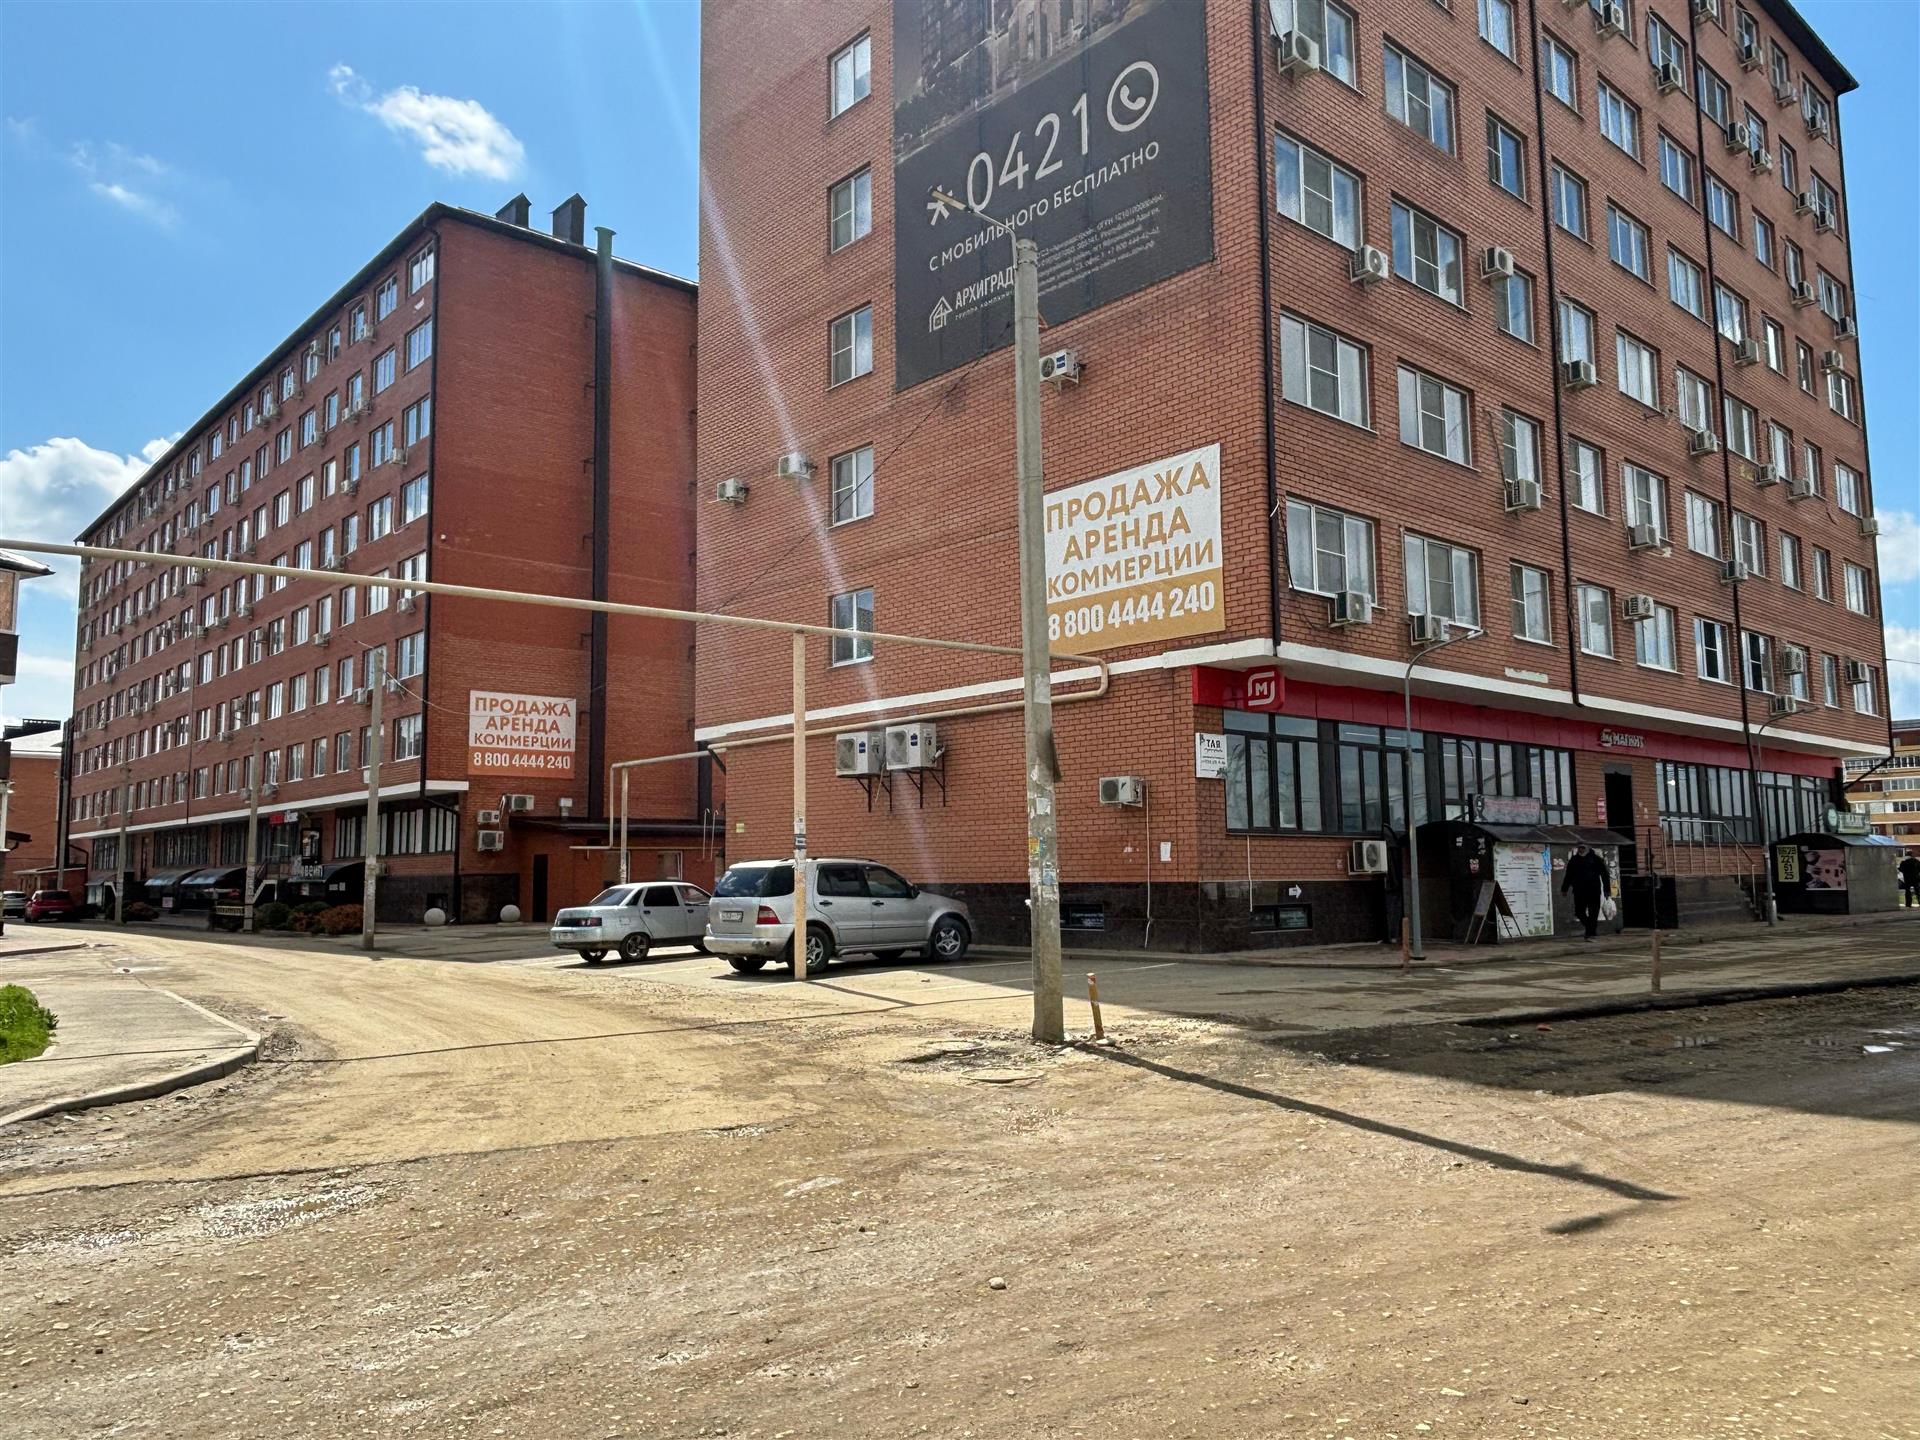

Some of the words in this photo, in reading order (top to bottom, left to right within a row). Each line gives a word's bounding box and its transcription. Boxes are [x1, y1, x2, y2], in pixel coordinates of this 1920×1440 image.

[929, 257, 939, 272] С
[942, 198, 1049, 267] МОБИЛЬНОГО
[1053, 141, 1159, 209] БЕСПЛАТНО
[955, 266, 1014, 310] АРХИГРАД
[1047, 461, 1211, 533] ПРОДАЖА
[1063, 506, 1191, 565] АРЕНДА
[1048, 538, 1213, 599] КОММЕРЦИИ
[1048, 613, 1060, 641] 8
[1065, 604, 1104, 638] 800
[1108, 591, 1165, 629] 4444
[1169, 581, 1215, 617] 240
[475, 697, 571, 717] ПРОДАЖА
[485, 716, 560, 735] АРЕНДА
[474, 733, 571, 749] КОММЕРЦИИ
[474, 752, 482, 766] 8
[485, 752, 510, 767] 800
[512, 754, 545, 768] 4444
[547, 755, 571, 769] 240
